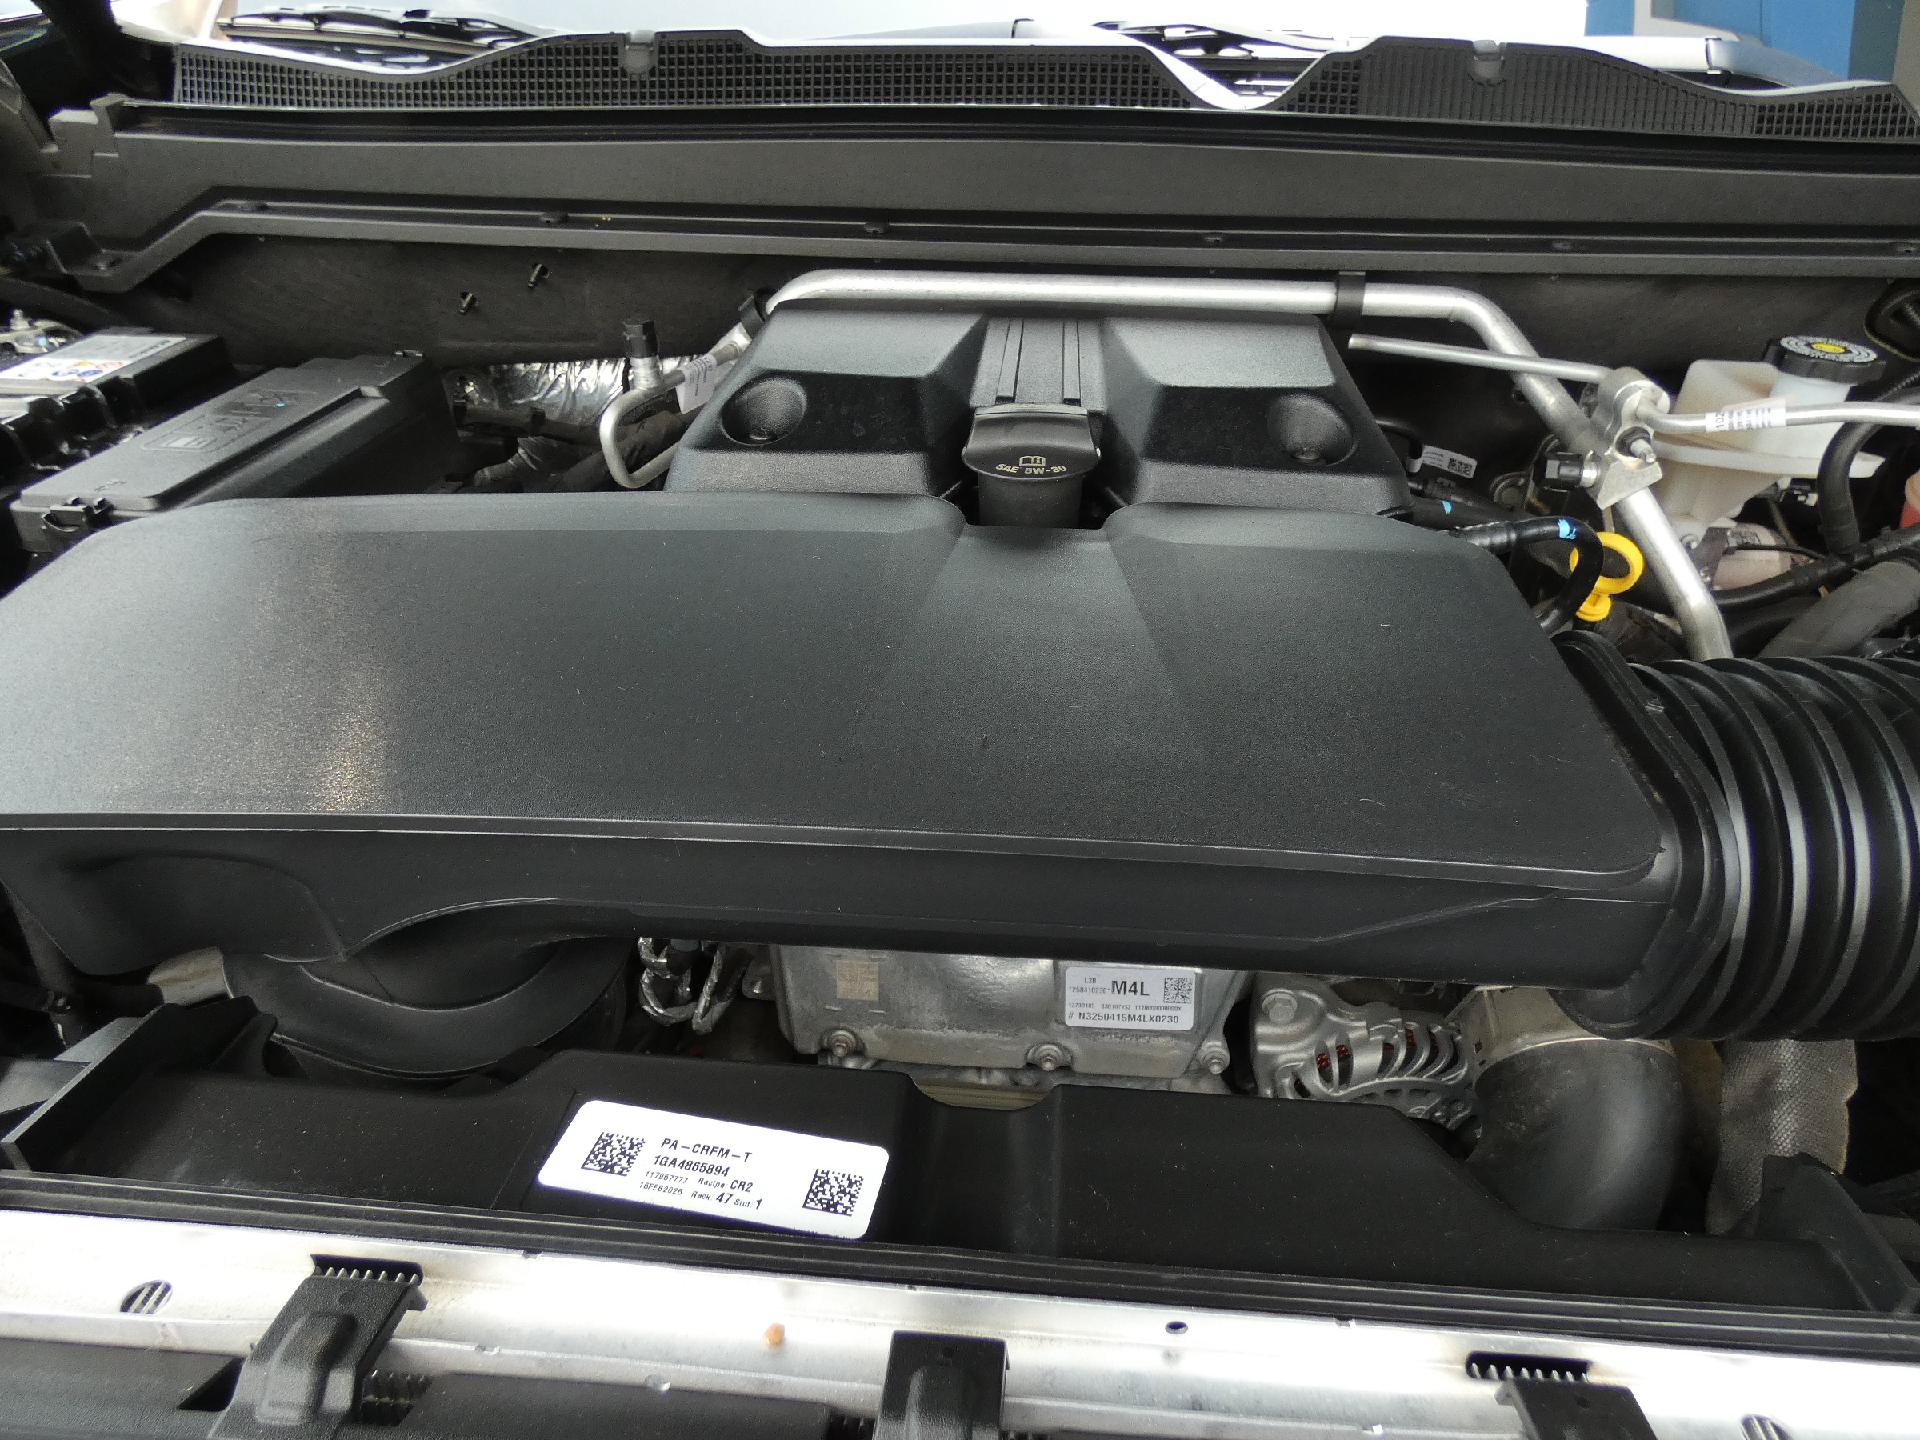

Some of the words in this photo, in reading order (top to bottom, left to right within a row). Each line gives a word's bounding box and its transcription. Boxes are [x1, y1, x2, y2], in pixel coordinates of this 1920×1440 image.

[995, 463, 1020, 473] SAE
[1111, 980, 1150, 996] M4L
[661, 1137, 753, 1162] PA-CRFM-T
[729, 1179, 754, 1193] CR2
[715, 1192, 734, 1204] 47
[756, 1198, 763, 1210] 1
